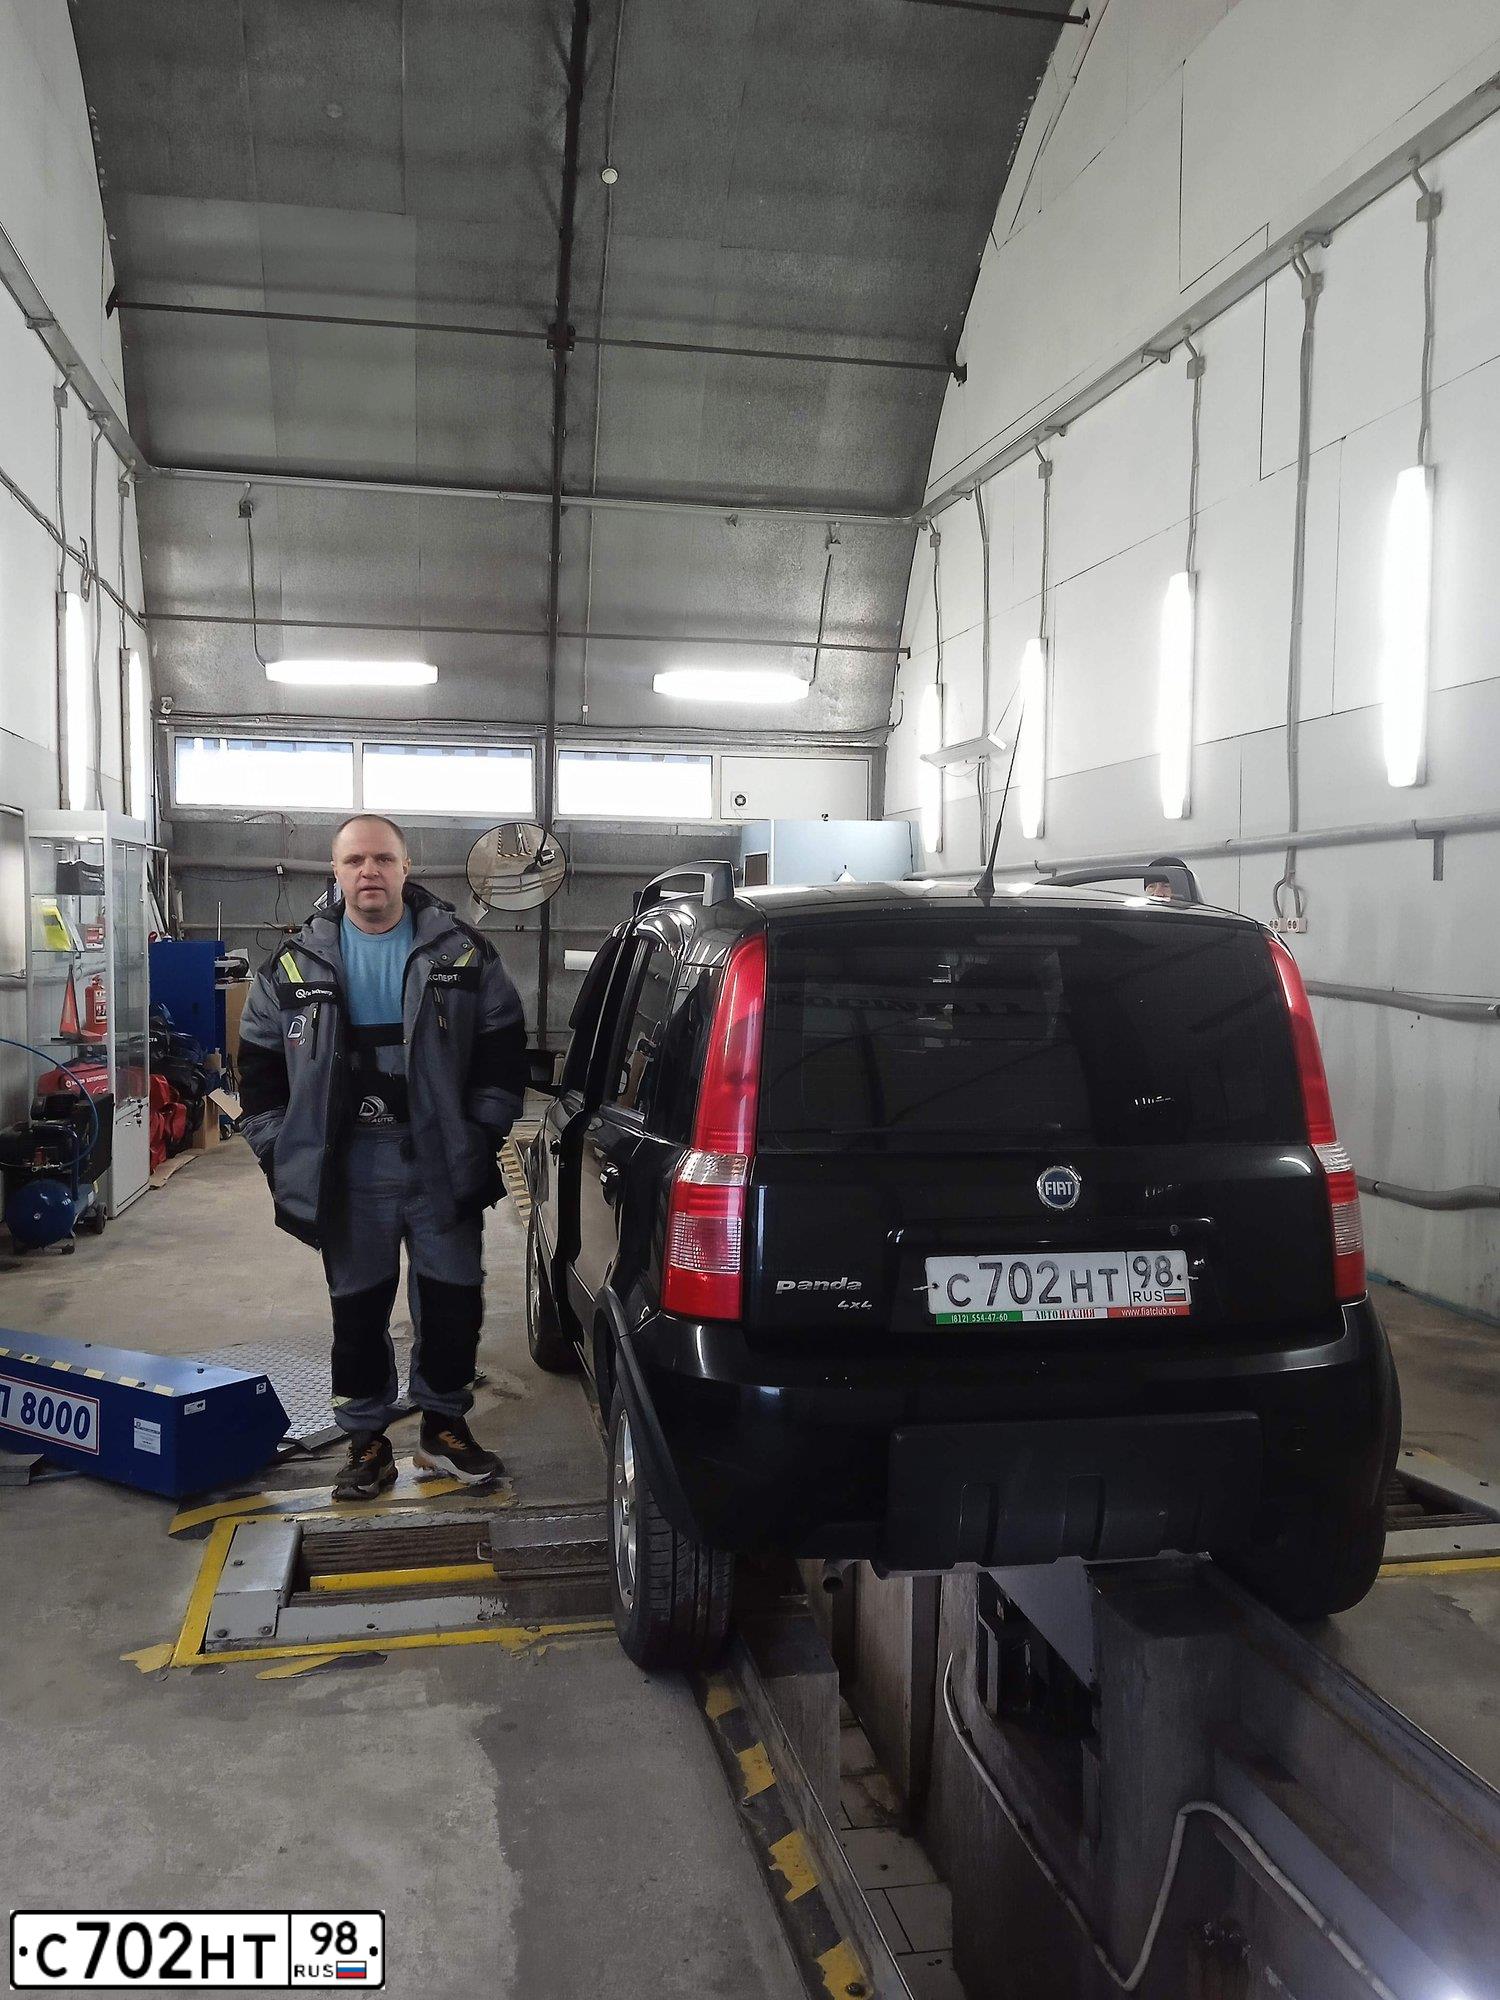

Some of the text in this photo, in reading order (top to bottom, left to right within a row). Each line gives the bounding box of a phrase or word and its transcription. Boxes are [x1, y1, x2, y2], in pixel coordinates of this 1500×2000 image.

[1044, 1181, 1073, 1196] FIAT
[1132, 1255, 1174, 1288] 98
[775, 1276, 862, 1294] panda
[1132, 1290, 1163, 1303] RUS
[837, 1300, 873, 1310] 4x4
[951, 1314, 969, 1324] (812)
[1121, 1308, 1177, 1317] www.fiatclub.ru
[21, 1391, 91, 1440] 8000
